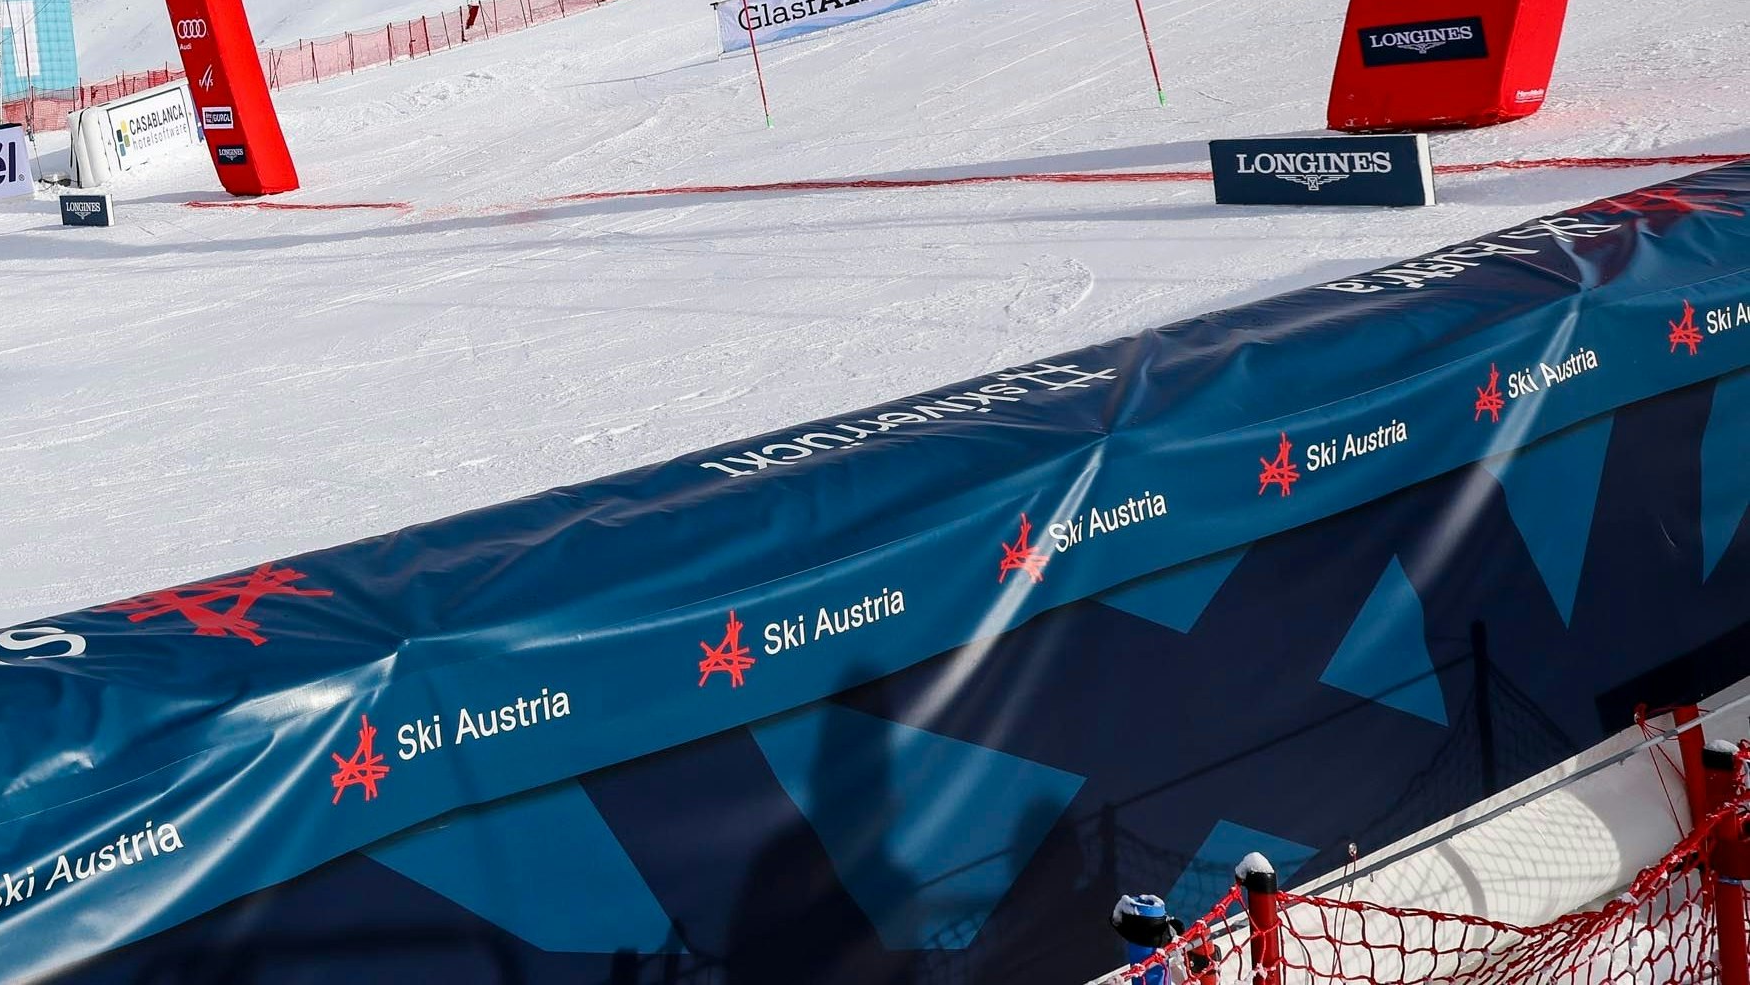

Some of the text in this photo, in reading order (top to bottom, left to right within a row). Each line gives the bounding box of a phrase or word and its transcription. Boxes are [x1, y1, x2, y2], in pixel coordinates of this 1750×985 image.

[1370, 25, 1473, 48] LONGINES
[129, 103, 185, 135] CASABLANCA
[132, 123, 187, 150] hotelsoftware
[218, 148, 244, 156] LONGINES
[1237, 151, 1392, 175] LONGINES
[65, 201, 101, 212] LONGINES
[1706, 306, 1732, 334] Ski
[1507, 347, 1599, 400] Ski Austria
[1305, 418, 1408, 471] Ski Austria
[1048, 490, 1168, 553] Ski Austria
[762, 587, 906, 656] Ski Austria
[397, 687, 571, 761] Ski Austria
[47, 819, 184, 889] Austria
